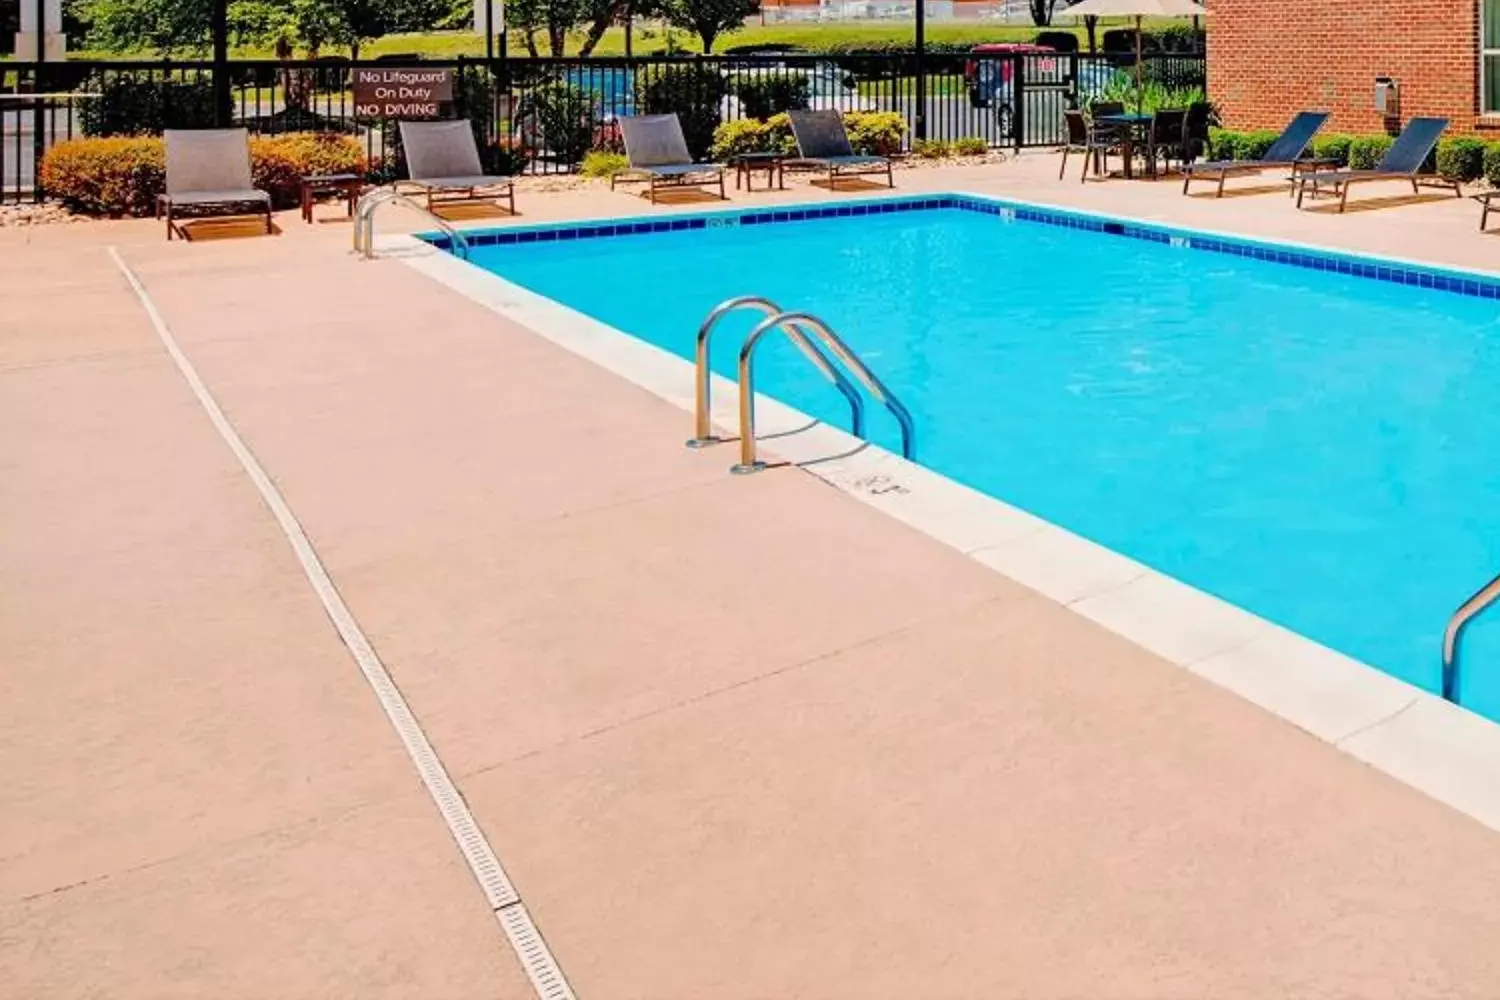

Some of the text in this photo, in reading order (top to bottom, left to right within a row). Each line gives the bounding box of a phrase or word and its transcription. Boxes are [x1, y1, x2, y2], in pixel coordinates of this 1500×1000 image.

[360, 71, 445, 84] No Lifeguard
[375, 87, 431, 100] On Duty
[356, 103, 437, 115] NO DIVING
